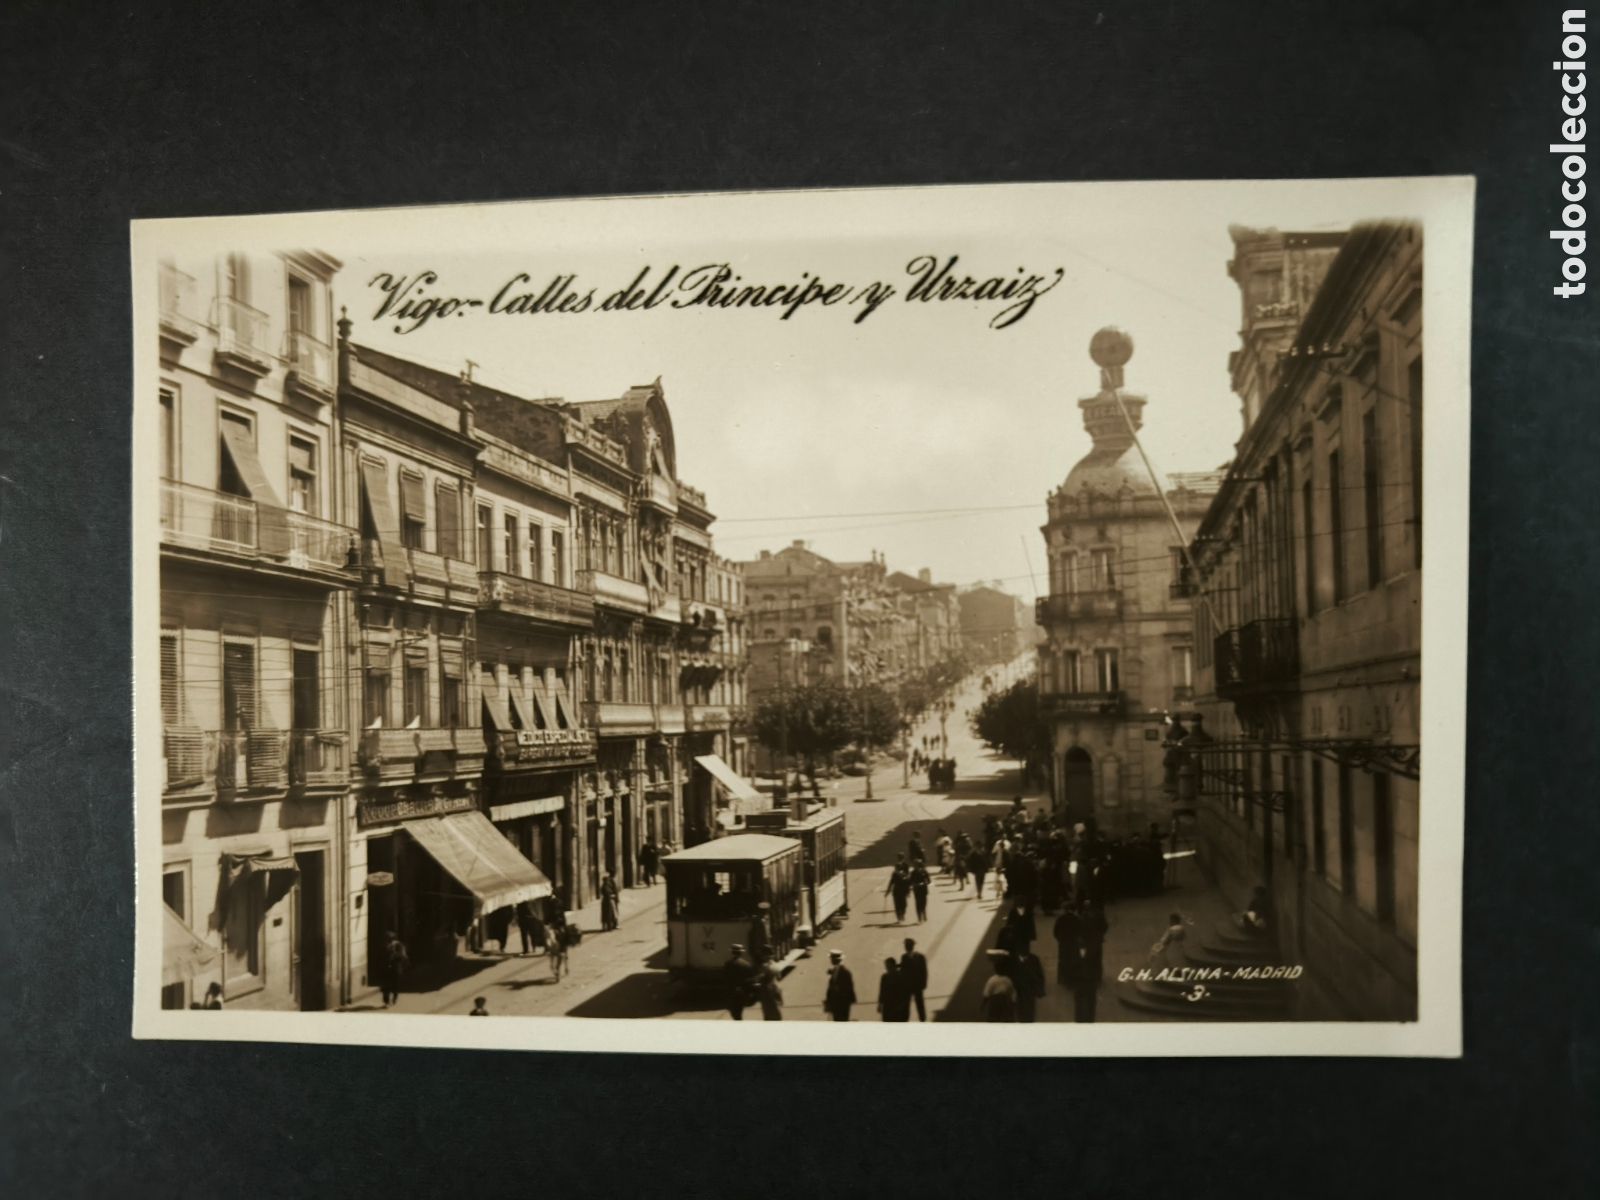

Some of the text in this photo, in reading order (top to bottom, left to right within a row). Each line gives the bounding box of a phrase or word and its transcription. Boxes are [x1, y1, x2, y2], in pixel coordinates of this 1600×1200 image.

[487, 272, 598, 316] Calles
[593, 263, 682, 313] del
[669, 262, 855, 321] Principe
[847, 280, 897, 326] y
[904, 253, 1066, 331] Urzaiz
